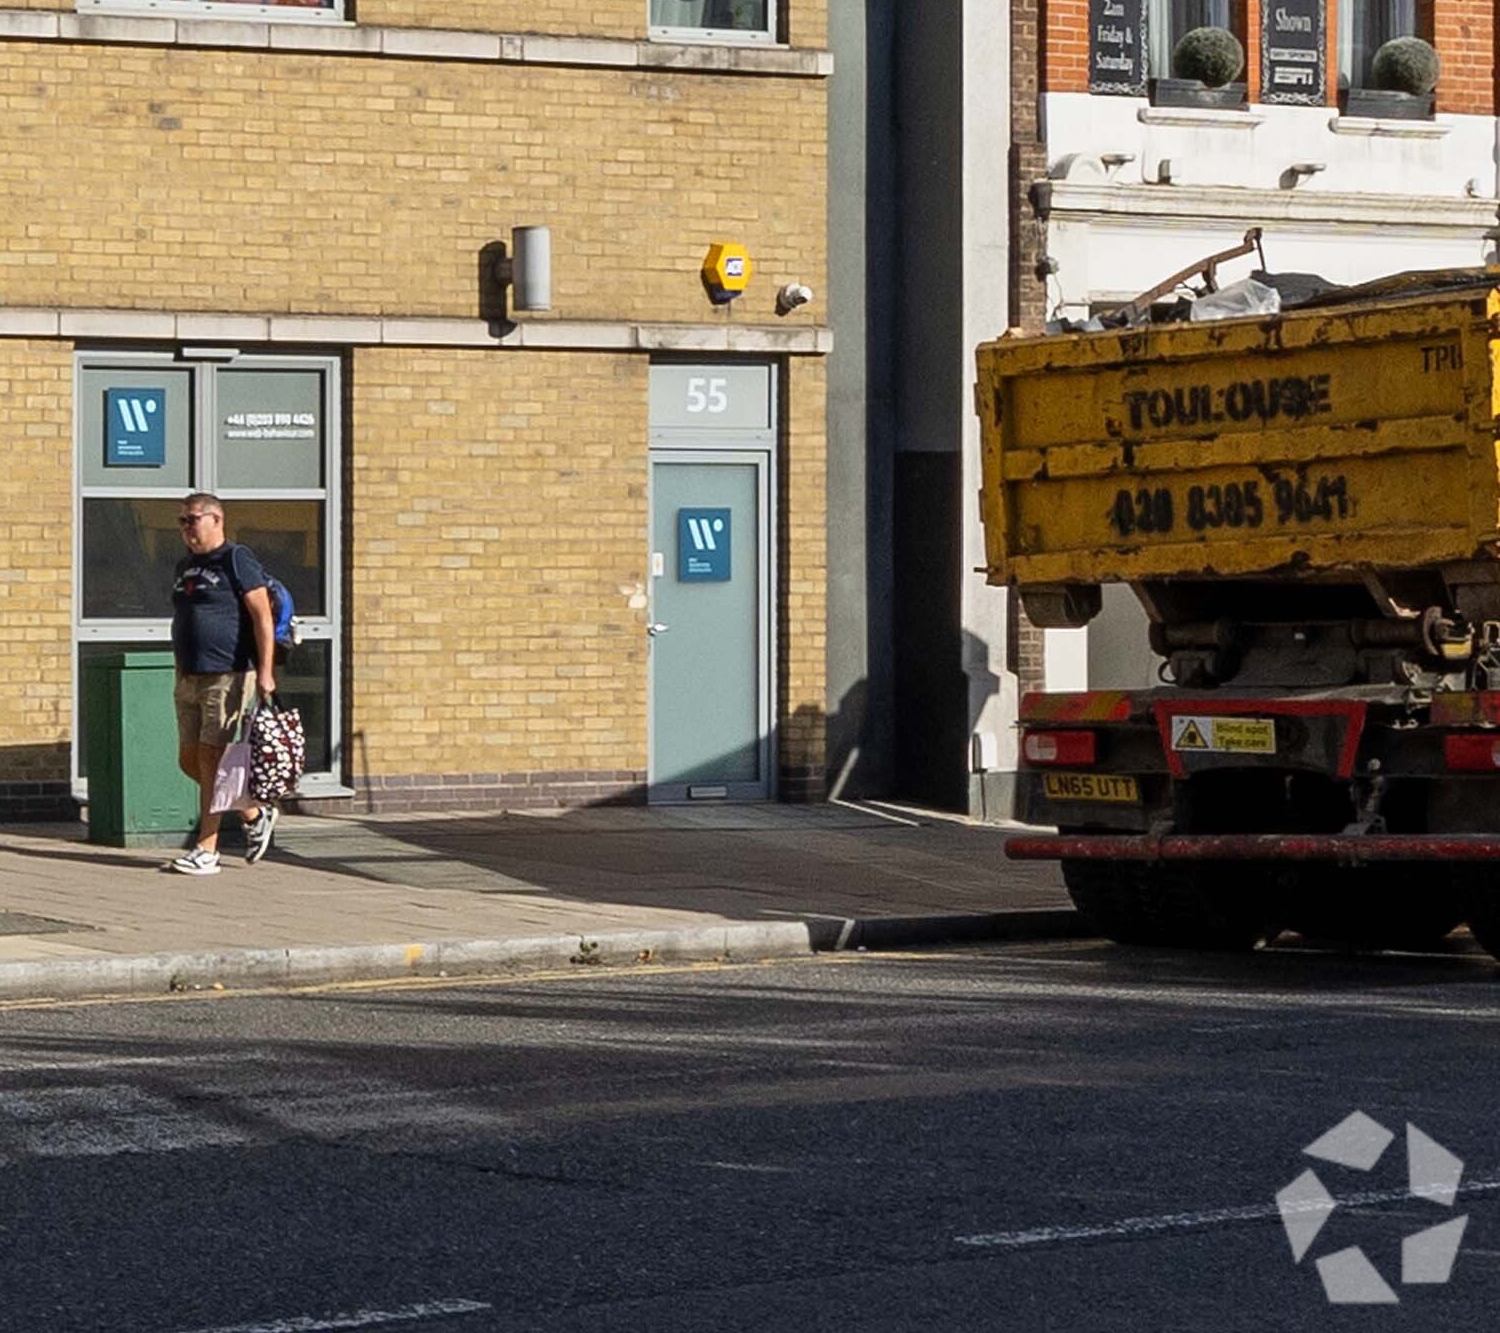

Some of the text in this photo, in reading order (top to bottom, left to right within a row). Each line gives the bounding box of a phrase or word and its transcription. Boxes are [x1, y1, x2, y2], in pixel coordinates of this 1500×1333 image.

[1276, 7, 1312, 32] Shown
[687, 378, 727, 413] 55
[1125, 374, 1332, 431] TOULOUSE
[1098, 776, 1133, 799] UTT
